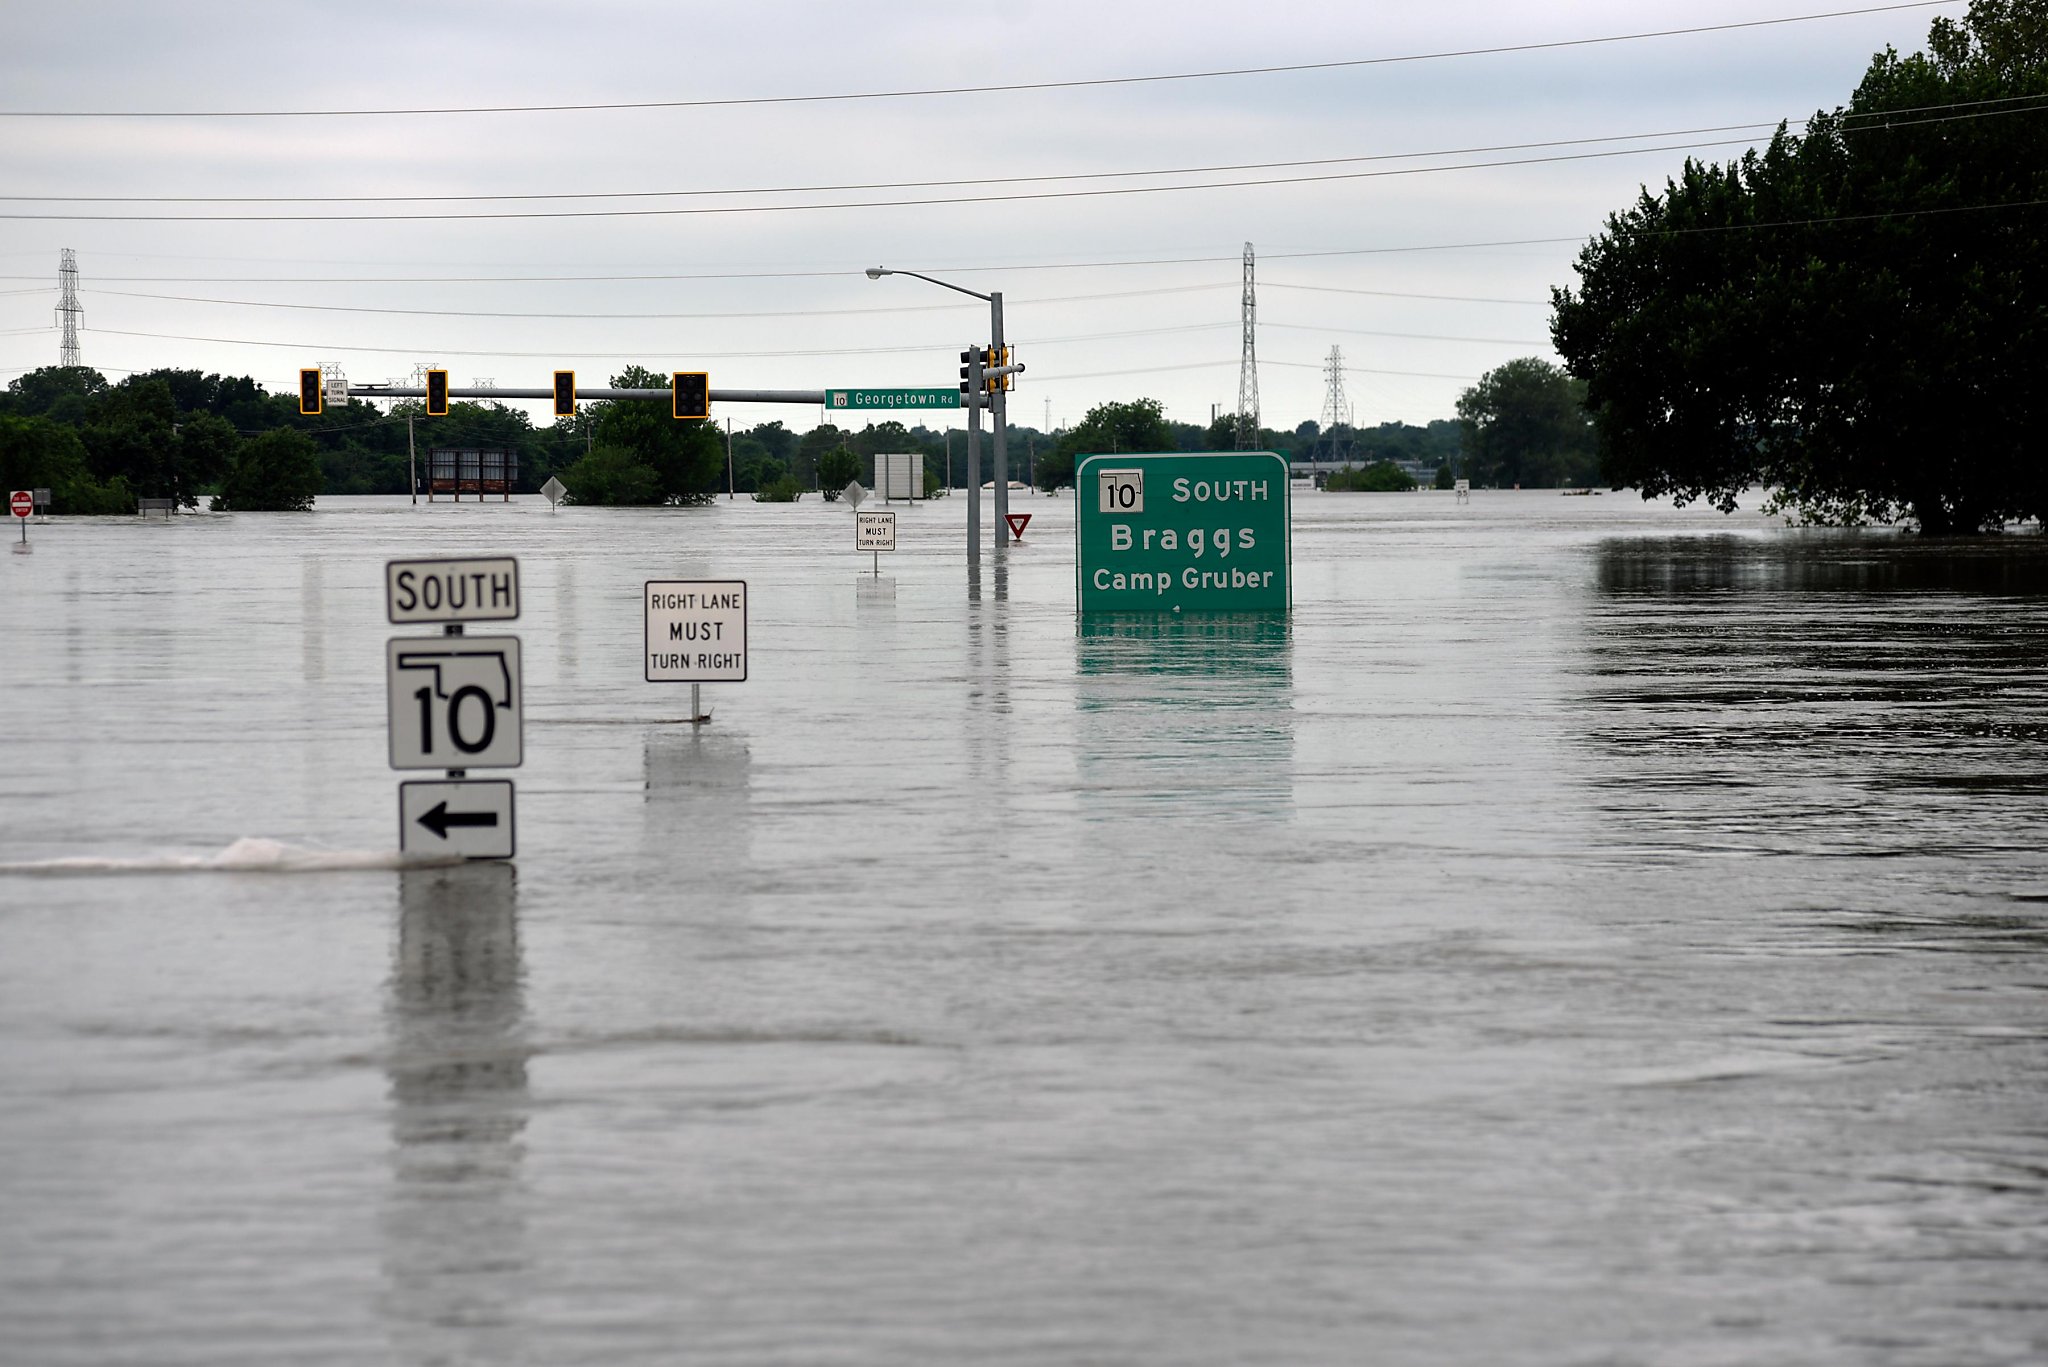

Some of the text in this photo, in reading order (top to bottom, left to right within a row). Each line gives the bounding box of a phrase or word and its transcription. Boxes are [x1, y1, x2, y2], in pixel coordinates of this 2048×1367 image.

[836, 392, 953, 408] 10 Georgetown Rd
[1107, 478, 1268, 508] 10 SOUTH
[866, 528, 886, 536] MUST
[1111, 524, 1256, 559] Braggs
[396, 571, 510, 611] SOUTH
[1094, 567, 1274, 596] Camp Gruber
[652, 594, 740, 609] RIGHT LANE
[670, 622, 723, 640] MUST
[650, 654, 742, 669] TURN RIGHT
[414, 685, 495, 754] 10
